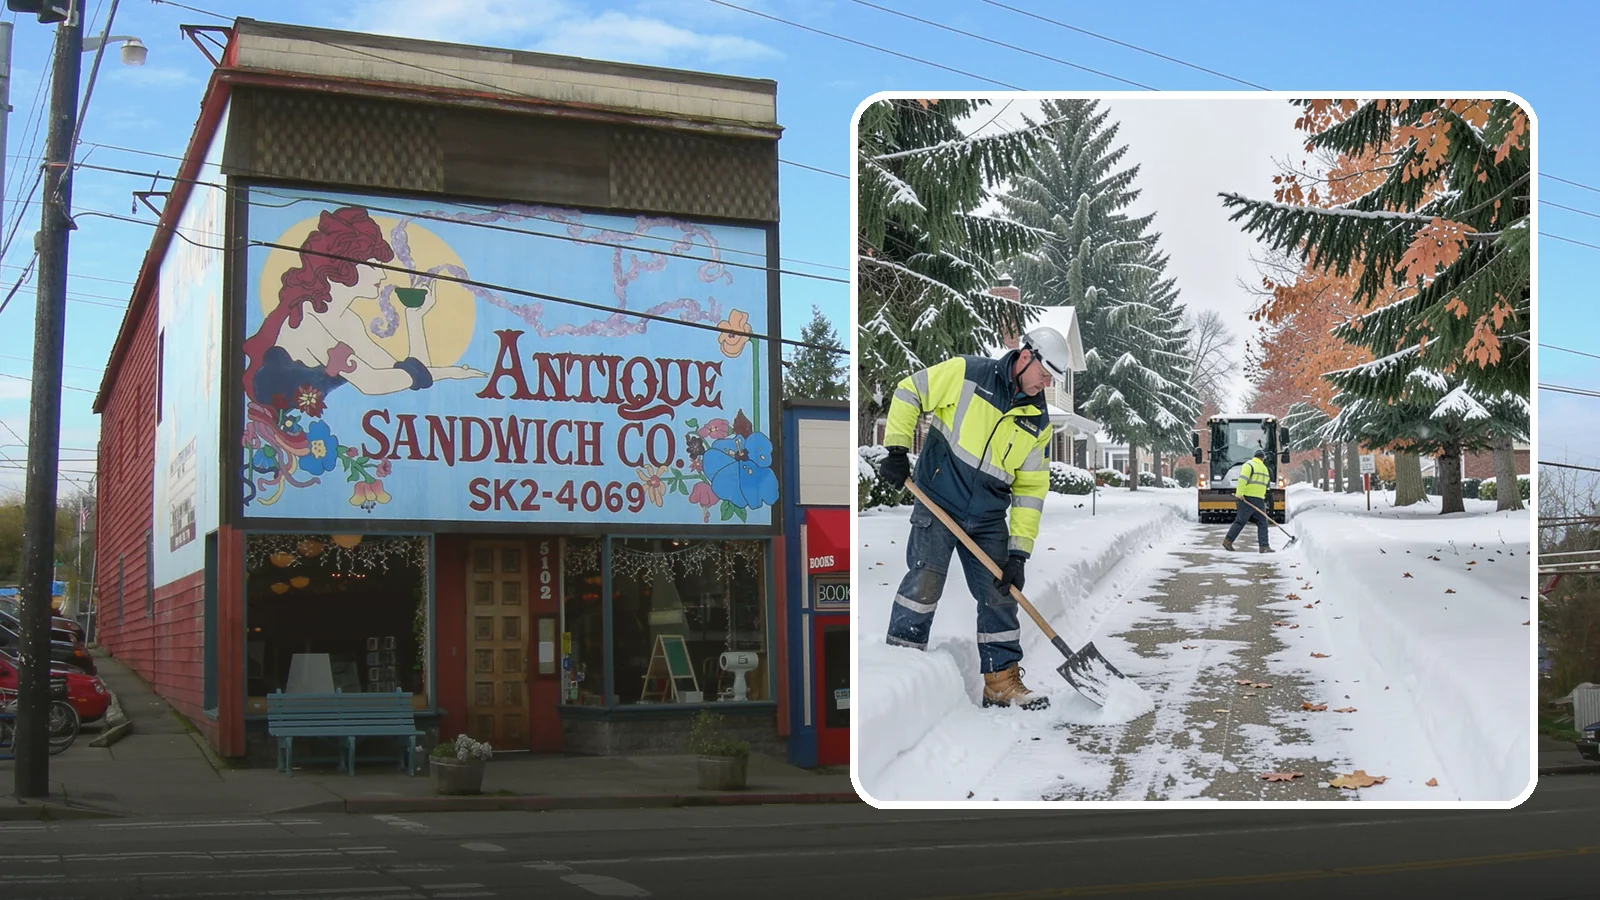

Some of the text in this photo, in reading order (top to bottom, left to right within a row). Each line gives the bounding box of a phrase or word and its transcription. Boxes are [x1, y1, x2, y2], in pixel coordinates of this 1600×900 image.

[476, 329, 724, 421] ANTIQUE
[361, 408, 685, 469] SANDWICH CO.
[468, 478, 646, 513] SK2-4069
[540, 541, 552, 599] 5102
[809, 555, 835, 569] BOOKS
